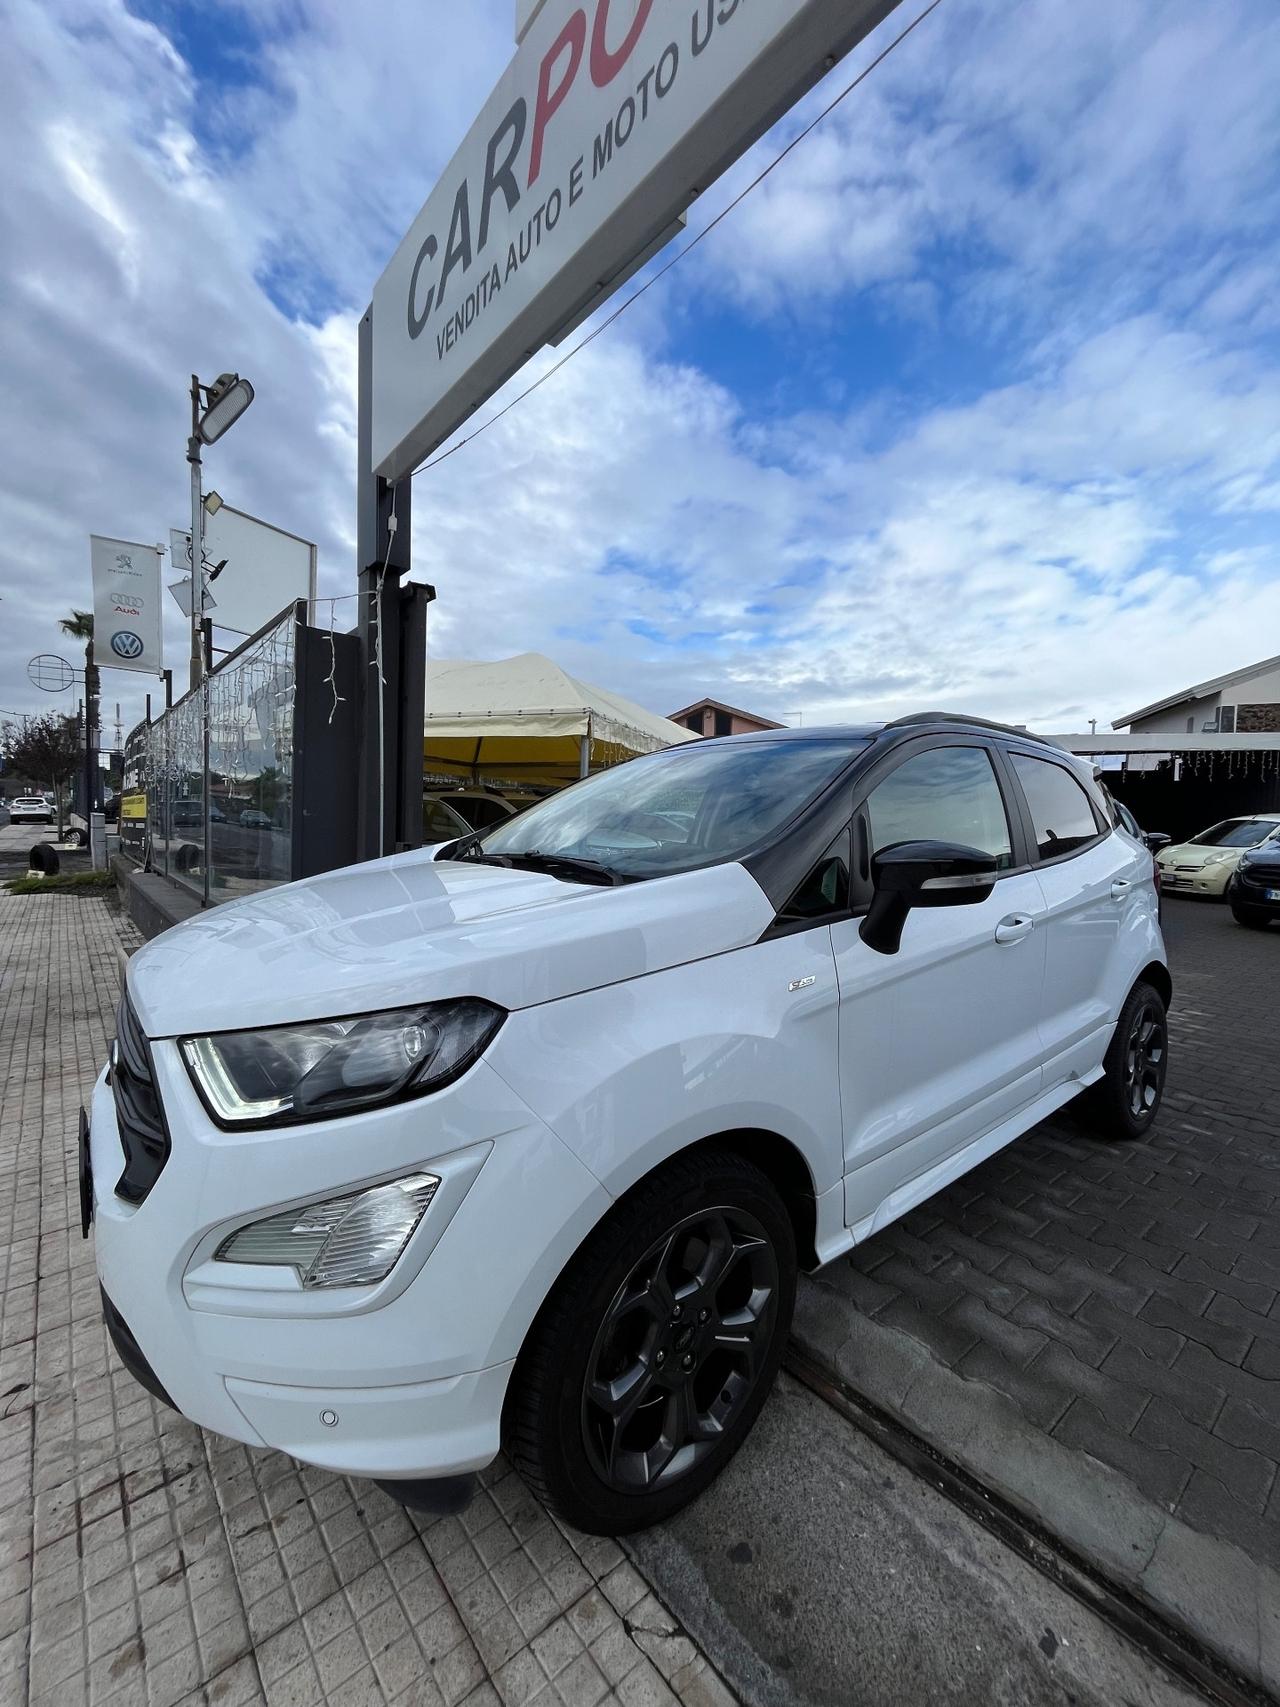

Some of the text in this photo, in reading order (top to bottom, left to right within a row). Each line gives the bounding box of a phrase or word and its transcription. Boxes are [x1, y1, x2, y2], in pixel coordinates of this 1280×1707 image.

[437, 262, 501, 360] VENDITA
[504, 188, 562, 283] AUTO
[569, 154, 584, 207] E
[593, 42, 679, 180] MOTO
[114, 605, 140, 616] Audi
